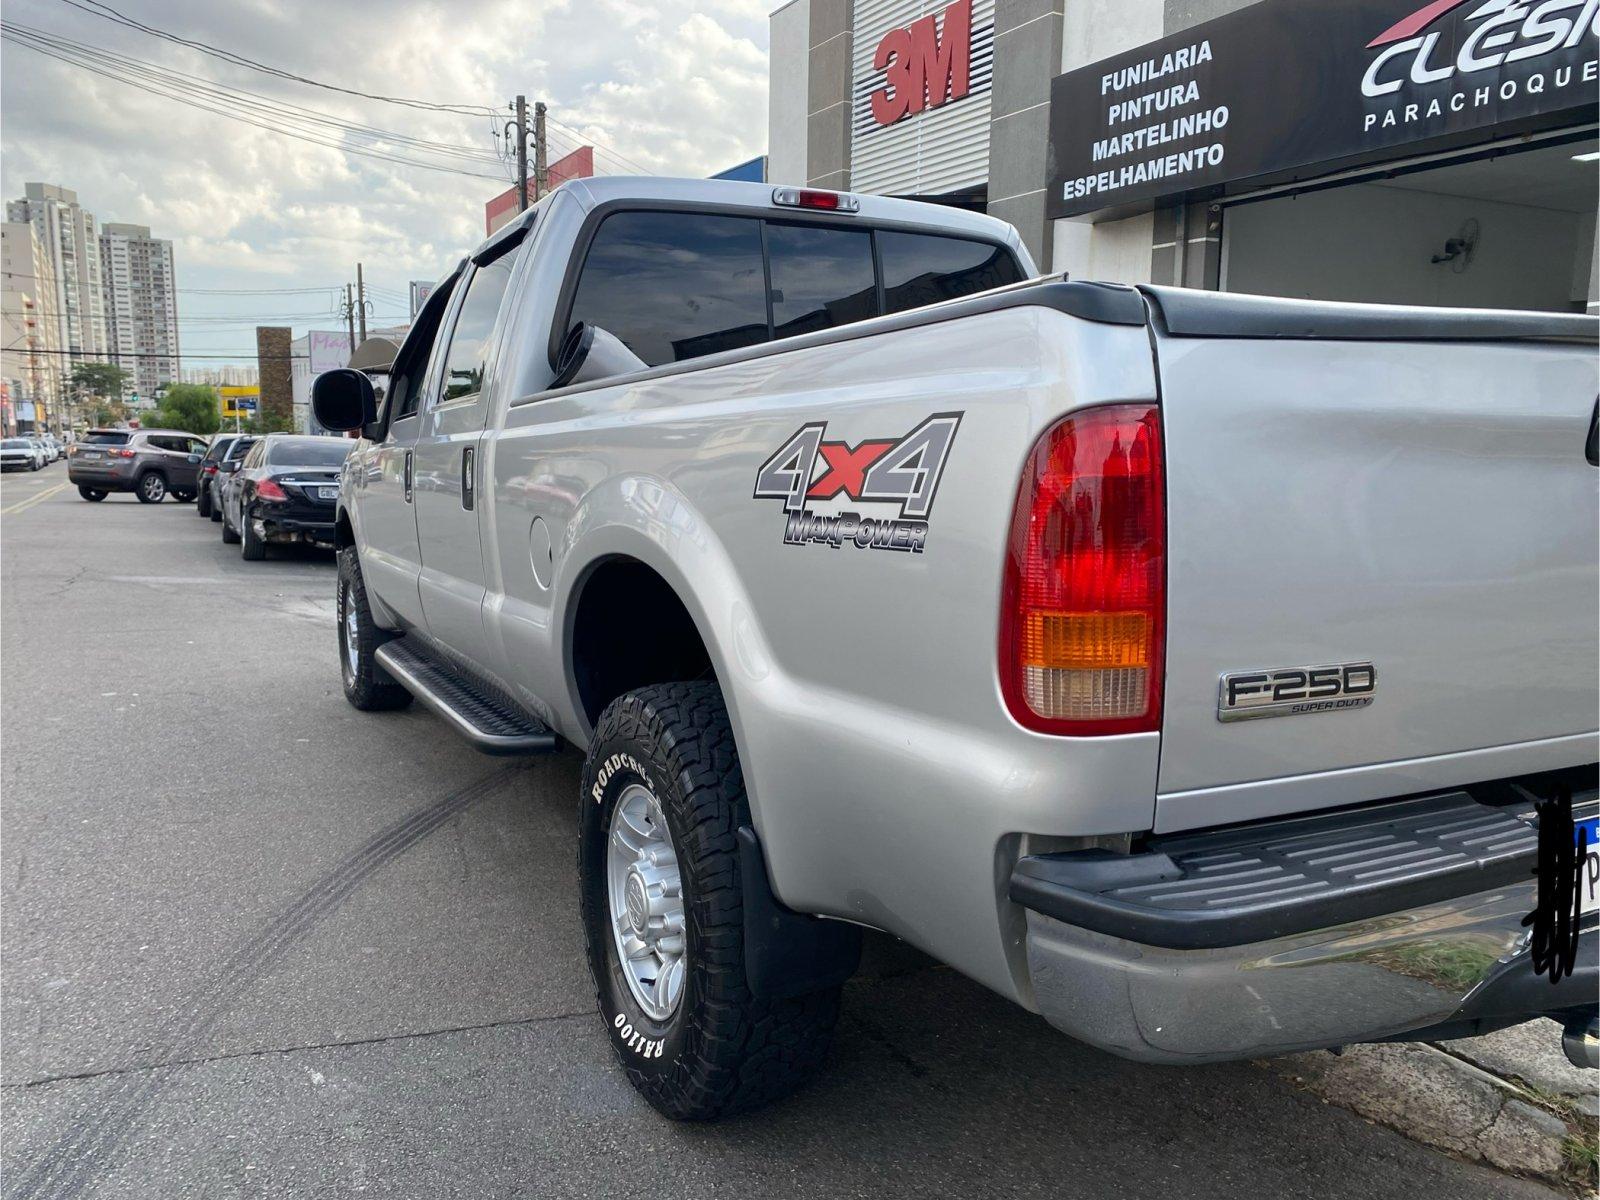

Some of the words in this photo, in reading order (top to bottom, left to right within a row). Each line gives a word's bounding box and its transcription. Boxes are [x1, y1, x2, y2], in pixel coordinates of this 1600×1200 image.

[871, 0, 971, 125] 3M
[1101, 40, 1213, 95] FUNILARIA
[1108, 80, 1200, 126] PINTURA
[1364, 60, 1599, 132] PARACHOQUE
[1092, 106, 1229, 161] MARTELINHO
[1063, 143, 1224, 200] ESPELHAMENTO
[1228, 665, 1375, 706] F-250
[1291, 700, 1333, 713] SUPER
[1337, 697, 1371, 708] DUTY
[614, 1013, 665, 1058] RA1100
